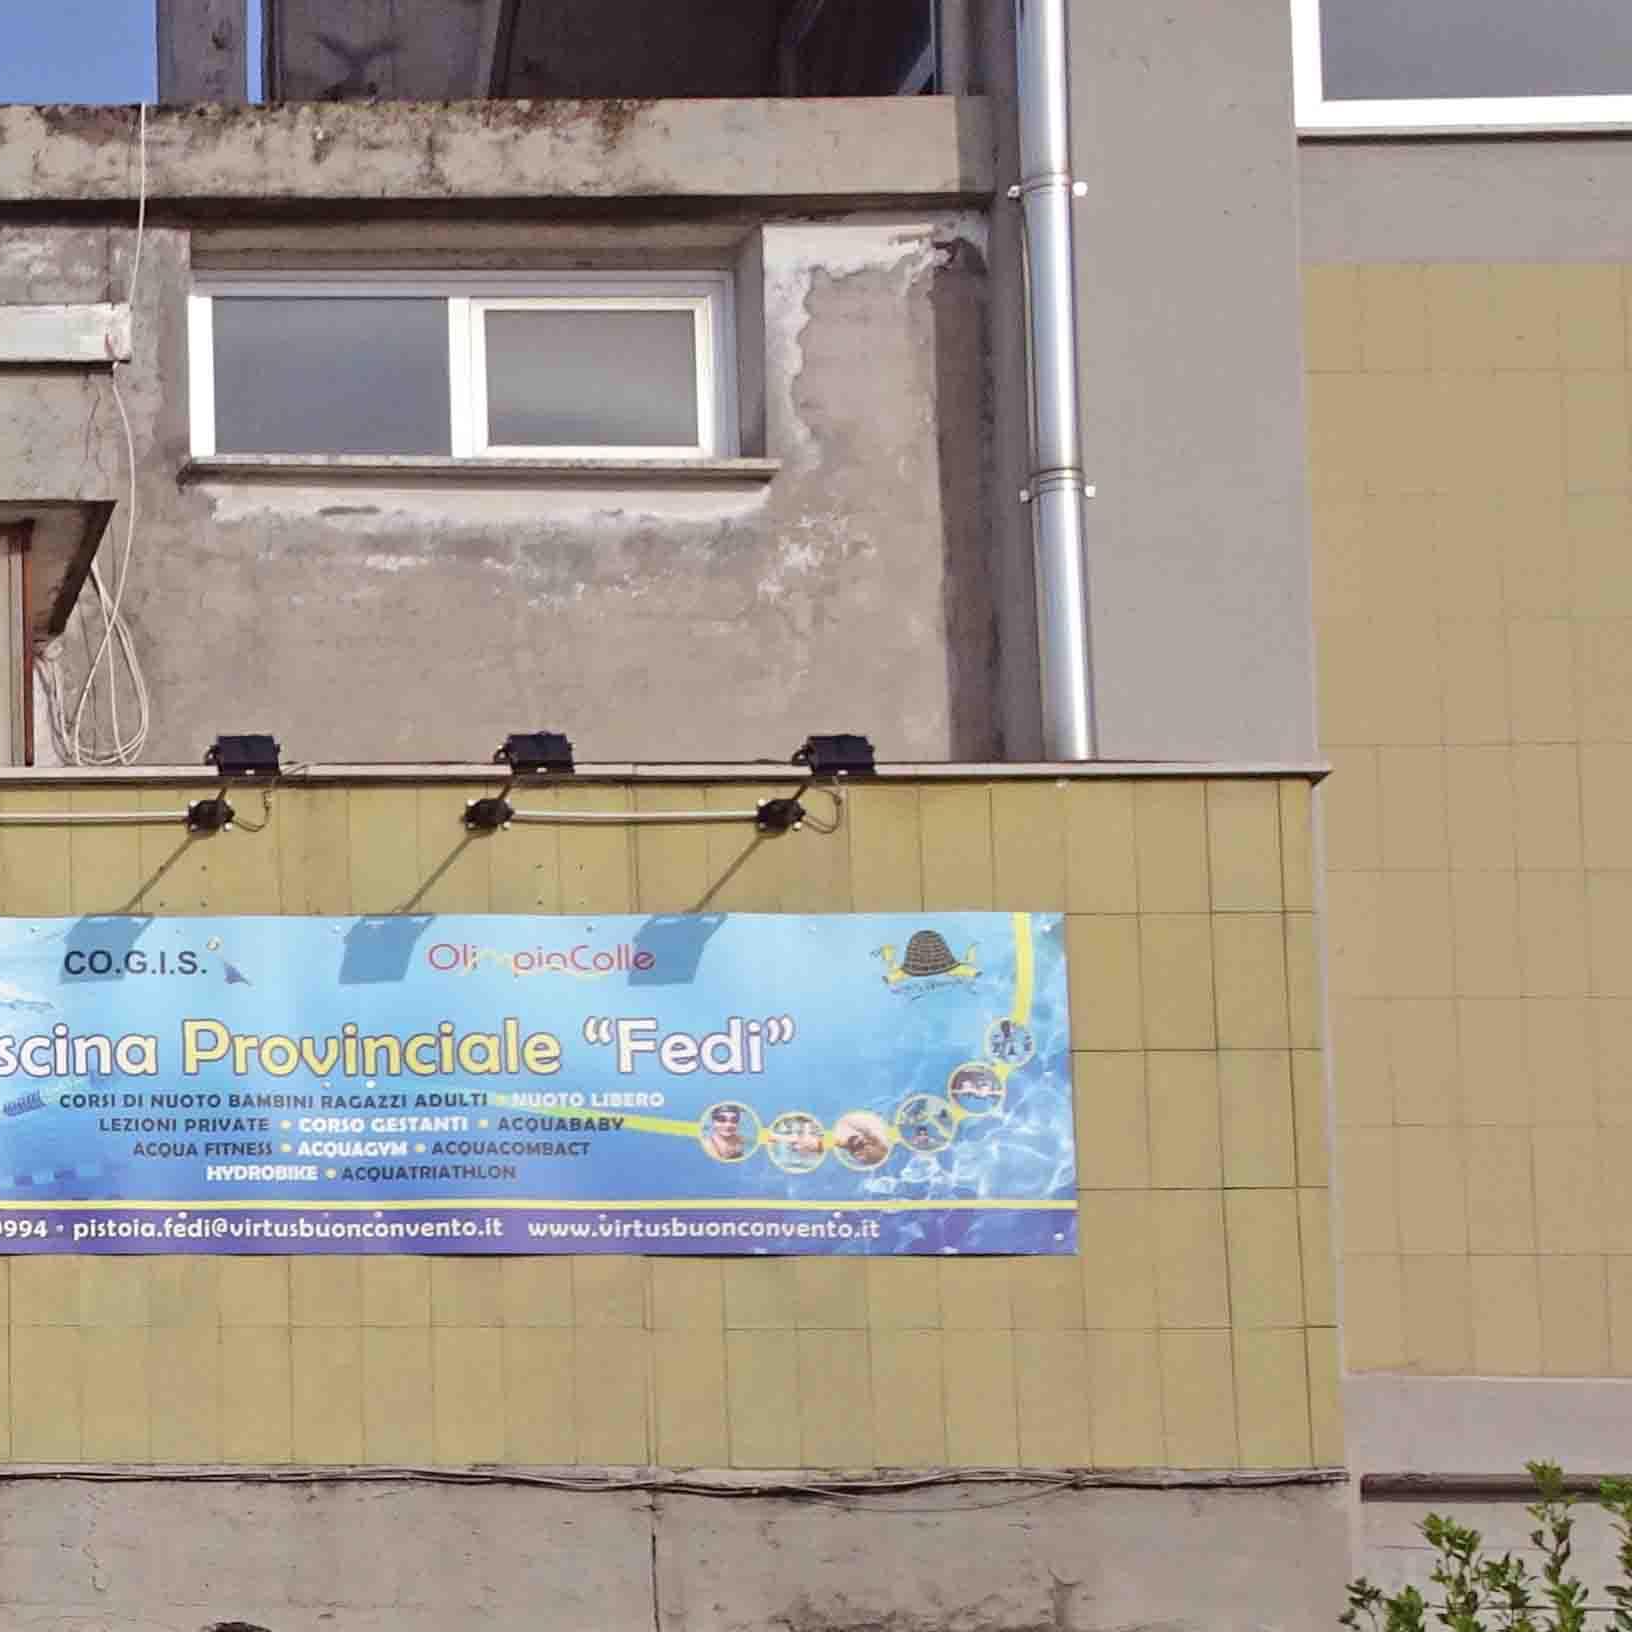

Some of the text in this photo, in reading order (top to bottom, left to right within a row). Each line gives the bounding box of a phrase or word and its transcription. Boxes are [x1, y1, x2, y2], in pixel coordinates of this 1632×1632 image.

[64, 950, 207, 975] CO.G.I.S.
[182, 1017, 562, 1078] Provinciale
[59, 1093, 666, 1109] CORSI DI NUOTO BAMBINI RAGAZZI ADULTI NUOTO LIBERO
[99, 1117, 625, 1133] LEZIONI PRIVATE CORSO GESTANTI ACQUABABY
[133, 1142, 592, 1157] ACQUA FITNESS ACQUAGYM ACQUACOMBACT
[206, 1165, 517, 1181] HYDROBIKE ACQUATRIATHLON
[71, 1215, 504, 1241] pistoia.fedi@virtusbuonconvento.it
[527, 1216, 881, 1239] www.virtusbuonconvento.it
